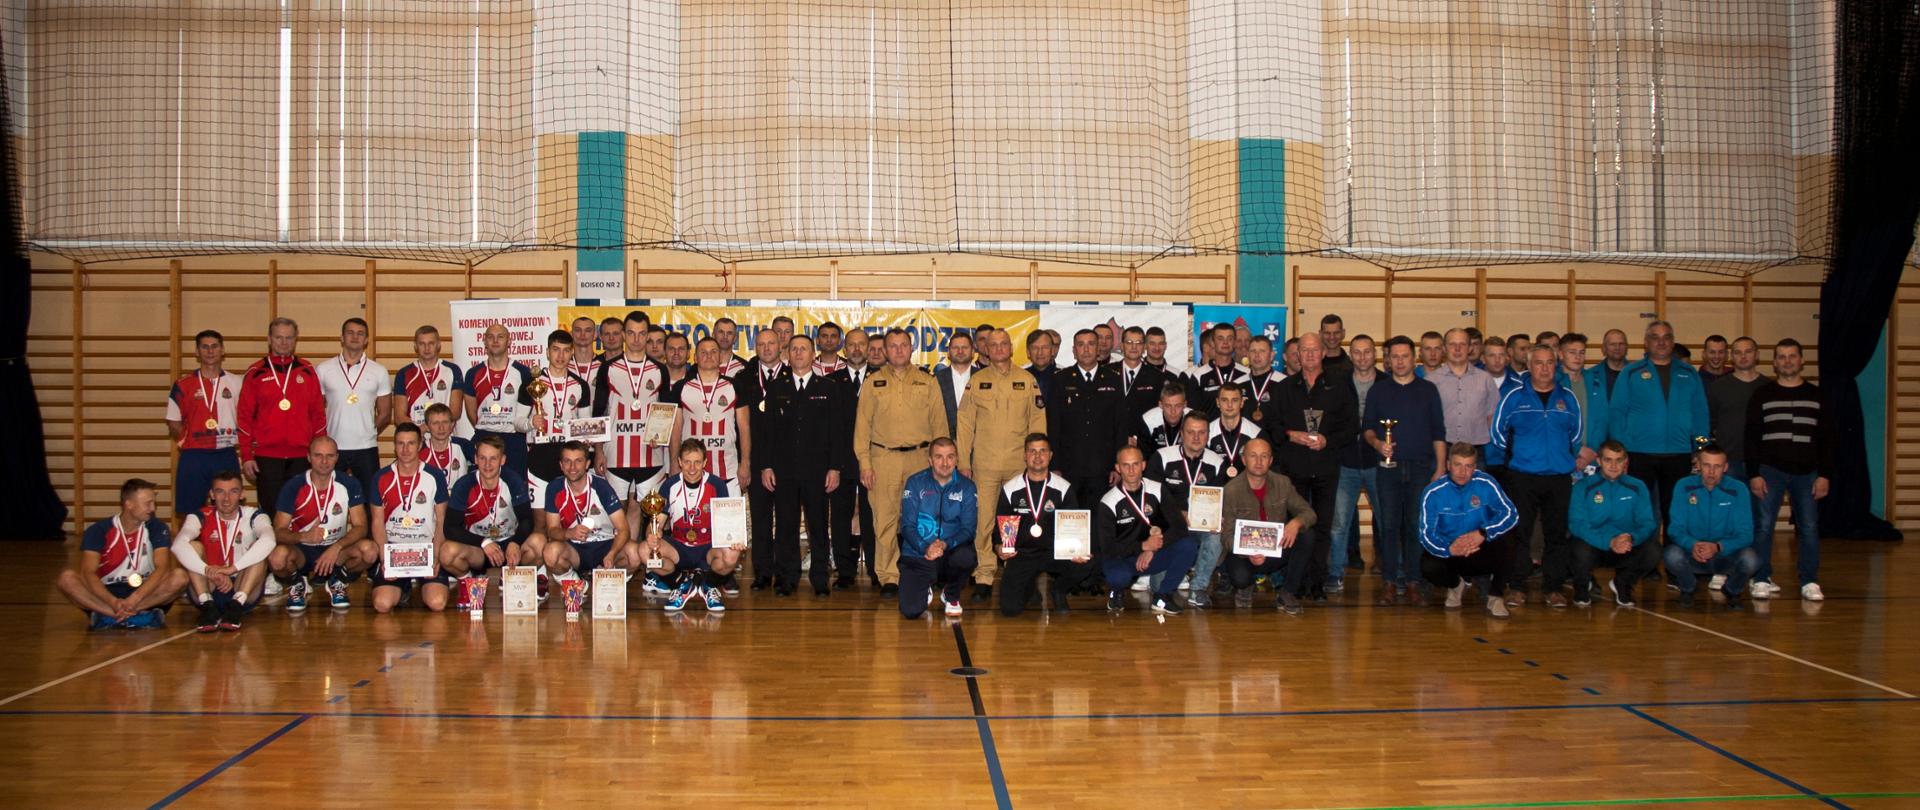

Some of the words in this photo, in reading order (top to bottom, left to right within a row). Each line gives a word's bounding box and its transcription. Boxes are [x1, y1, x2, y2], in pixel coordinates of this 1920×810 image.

[507, 343, 543, 355] OŻARNEJ
[616, 423, 633, 433] KM
[707, 438, 725, 447] PSP
